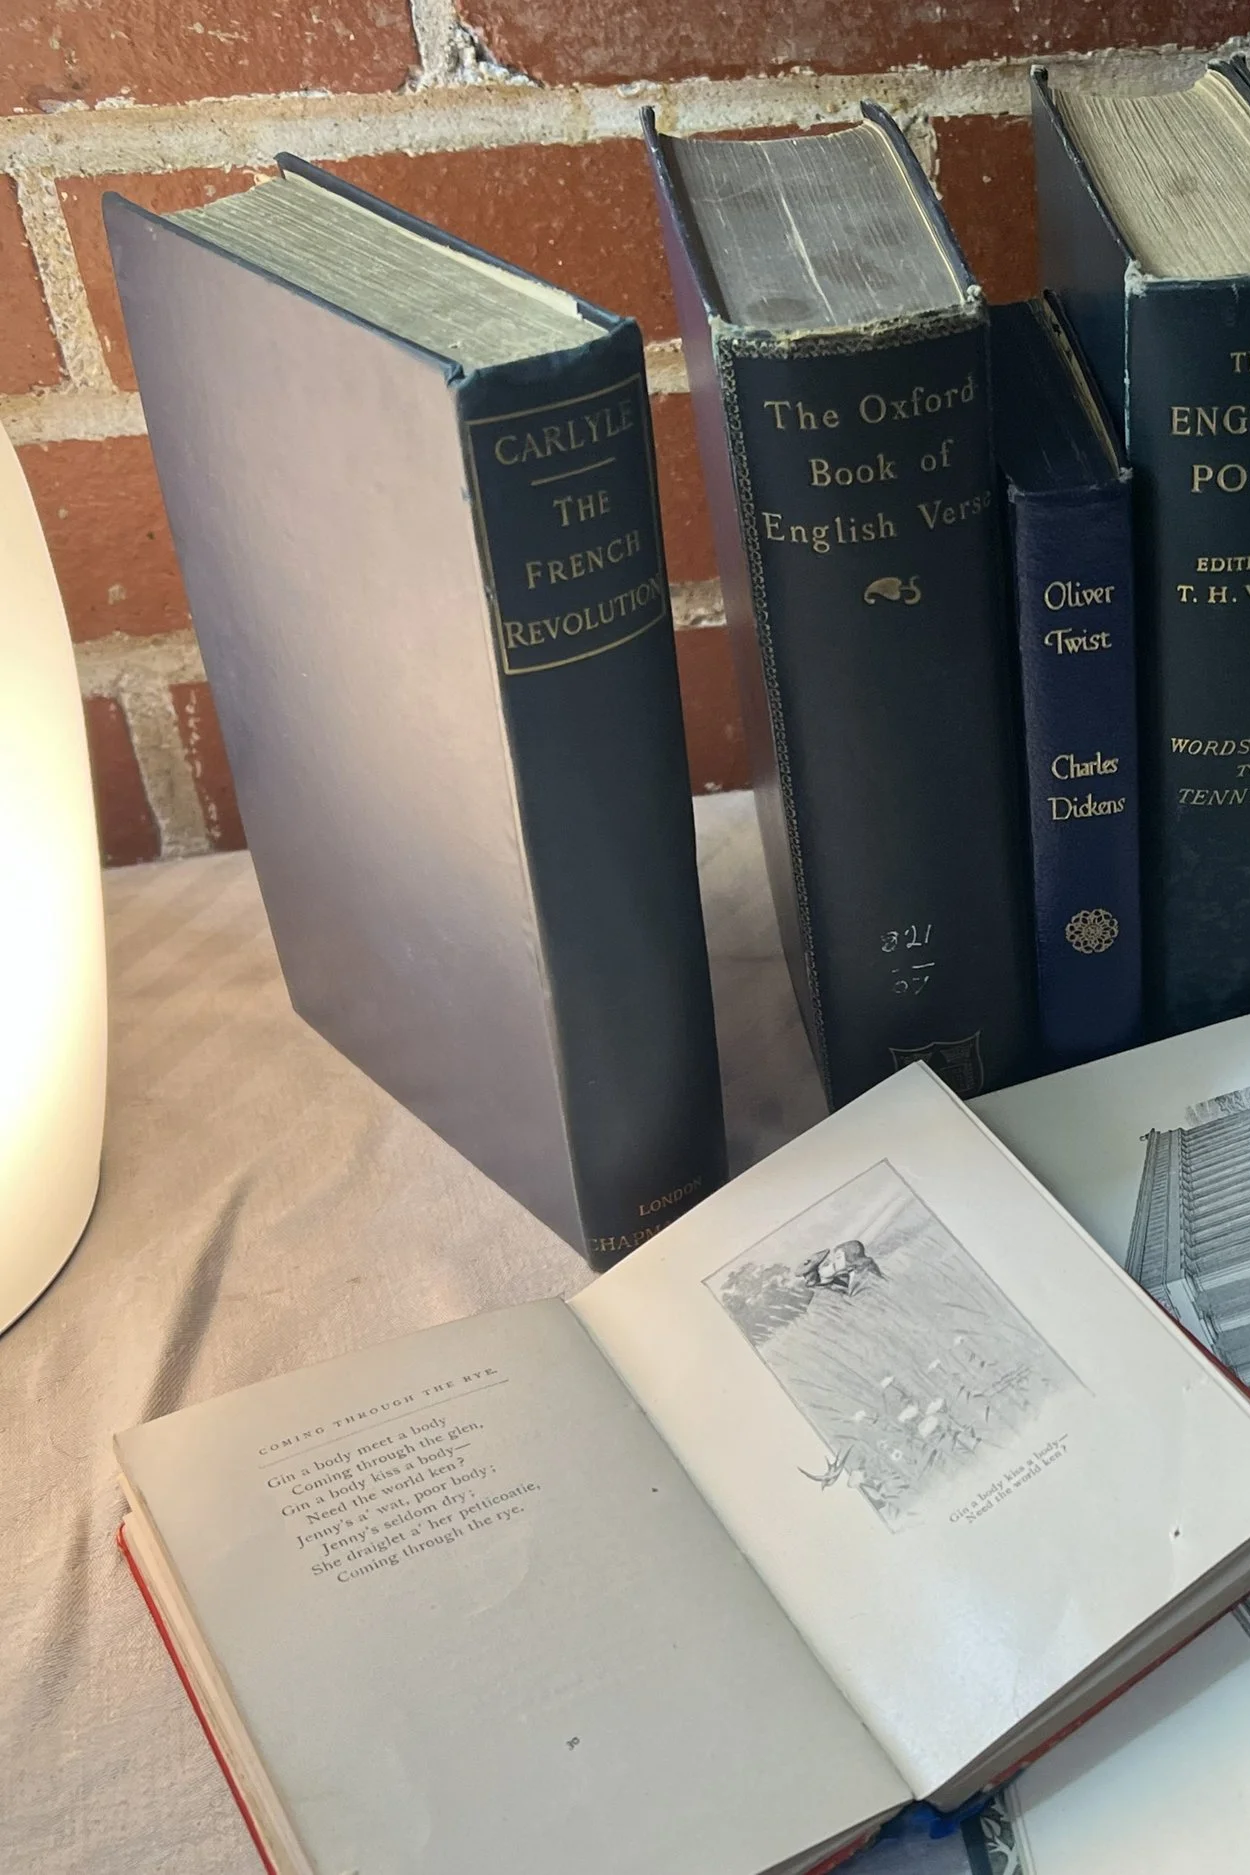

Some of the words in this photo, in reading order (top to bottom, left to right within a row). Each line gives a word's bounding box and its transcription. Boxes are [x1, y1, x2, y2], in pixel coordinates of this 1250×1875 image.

[764, 400, 840, 430] The
[860, 371, 978, 423] Oxford
[494, 399, 635, 465] CARLYLE
[808, 453, 898, 487] Book
[921, 438, 955, 472] of
[553, 490, 611, 527] THE
[762, 512, 897, 553] English
[525, 530, 641, 590] FRENCH
[504, 572, 665, 648] REVOLUTION
[1044, 580, 1115, 611] Oliver
[1177, 585, 1198, 603] T.
[1208, 586, 1237, 603] H.
[1044, 628, 1112, 655] Twist
[1051, 752, 1119, 780] Charles
[1047, 793, 1126, 820] Dickens
[639, 1175, 702, 1217] LONDON
[259, 1426, 326, 1456] COMING
[332, 1394, 415, 1428] THROUGH
[422, 1380, 455, 1396] THE
[462, 1367, 498, 1384] RYE.
[266, 1472, 297, 1490] Gin
[314, 1448, 351, 1471] body
[357, 1435, 395, 1456] meet
[410, 1415, 448, 1437] body
[291, 1466, 352, 1496] Coming
[356, 1443, 417, 1473] through
[419, 1431, 444, 1449] the
[448, 1422, 484, 1442] glen,
[281, 1499, 312, 1518] Gin
[329, 1478, 366, 1500] body
[372, 1464, 401, 1483] kiss
[295, 1519, 354, 1550] Jenny's
[414, 1481, 449, 1504] poor
[451, 1464, 498, 1487] body;
[305, 1502, 348, 1525] Need
[352, 1490, 378, 1509] the
[381, 1471, 426, 1495] world
[431, 1456, 466, 1479] ken?
[965, 1501, 994, 1524] Need
[1013, 1464, 1042, 1488] world
[977, 1480, 1004, 1501] body
[1003, 1465, 1026, 1483] kiss
[311, 1559, 342, 1577] She
[347, 1533, 406, 1562] draiglet
[428, 1512, 454, 1532] her
[460, 1483, 541, 1519] petticoatie,
[321, 1525, 379, 1557] Jenny's
[384, 1503, 438, 1531] seldom
[442, 1488, 476, 1508] dry;
[337, 1555, 401, 1584] Coming
[403, 1528, 464, 1559] through
[467, 1515, 493, 1533] the
[496, 1505, 525, 1523] rye.
